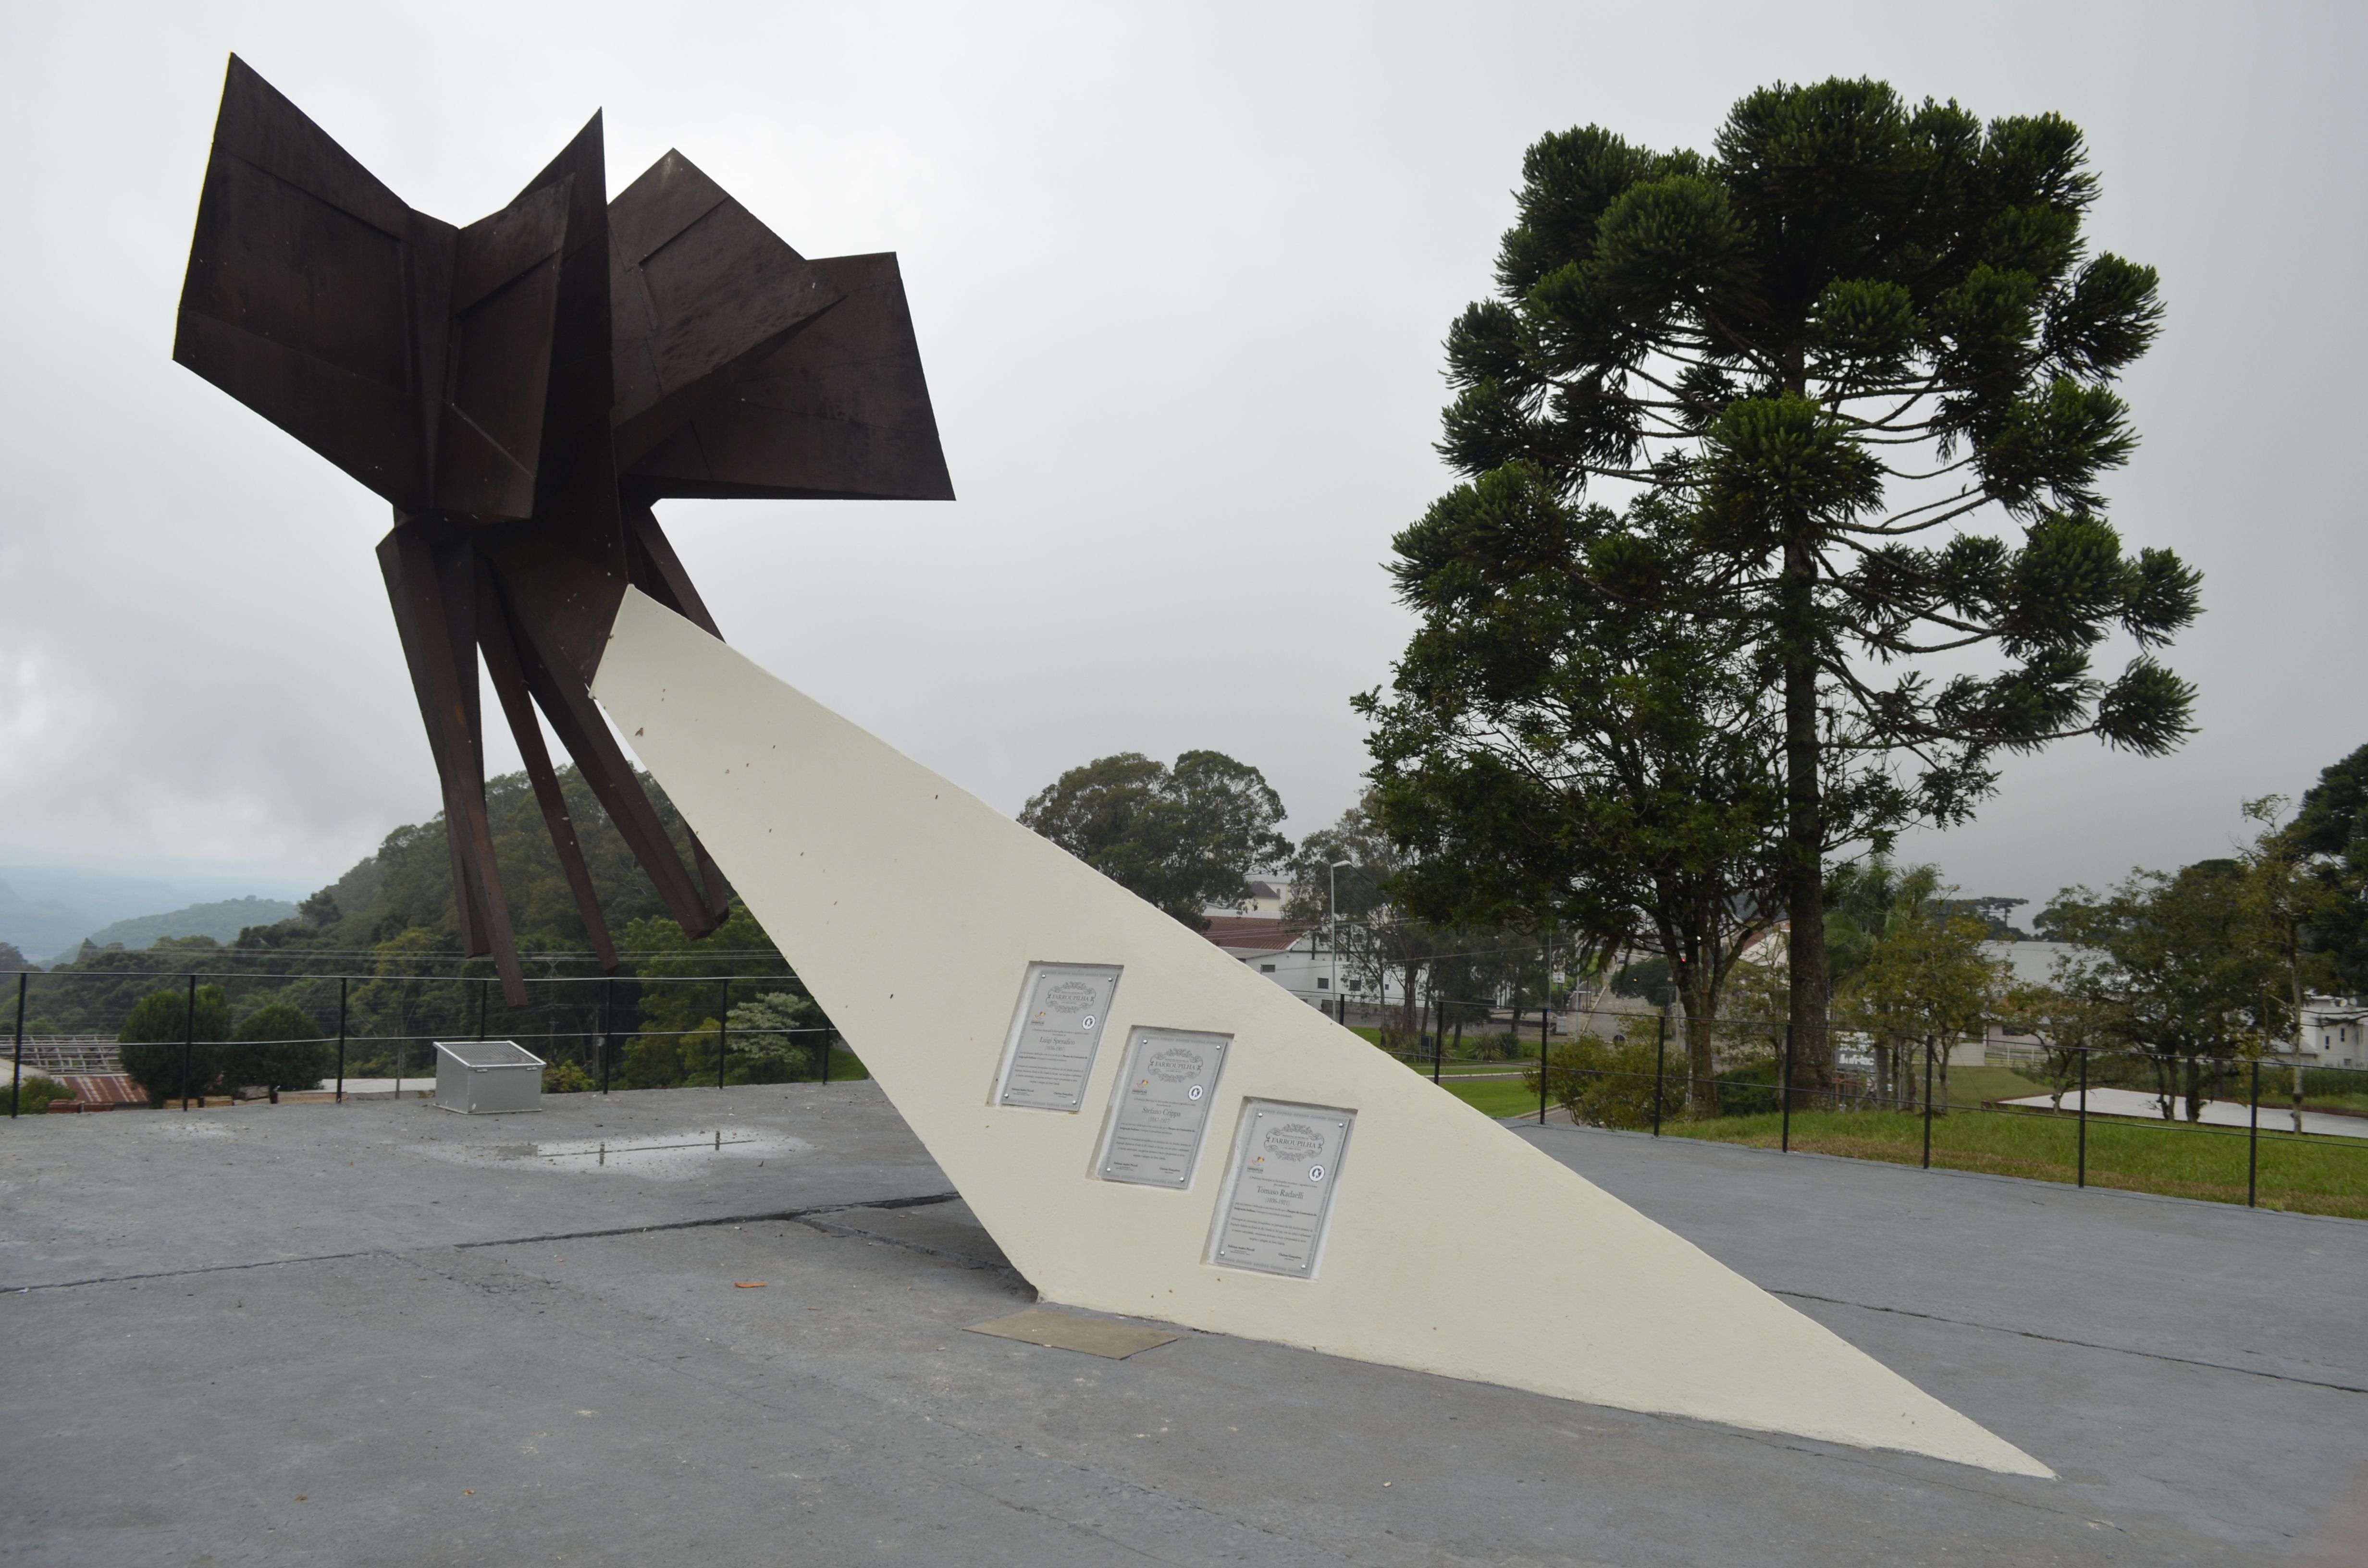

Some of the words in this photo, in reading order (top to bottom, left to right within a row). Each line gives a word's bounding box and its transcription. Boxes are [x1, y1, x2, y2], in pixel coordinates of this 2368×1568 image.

[1039, 1036, 1052, 1045] Luigi
[1155, 1061, 1196, 1070] FARROUPILHA
[1142, 1106, 1162, 1115] Stefano
[1163, 1109, 1181, 1118] Crippa
[1271, 1138, 1316, 1148] FARROUPILHA
[1257, 1186, 1279, 1196] Tomaso
[1280, 1189, 1304, 1200] Radaelli
